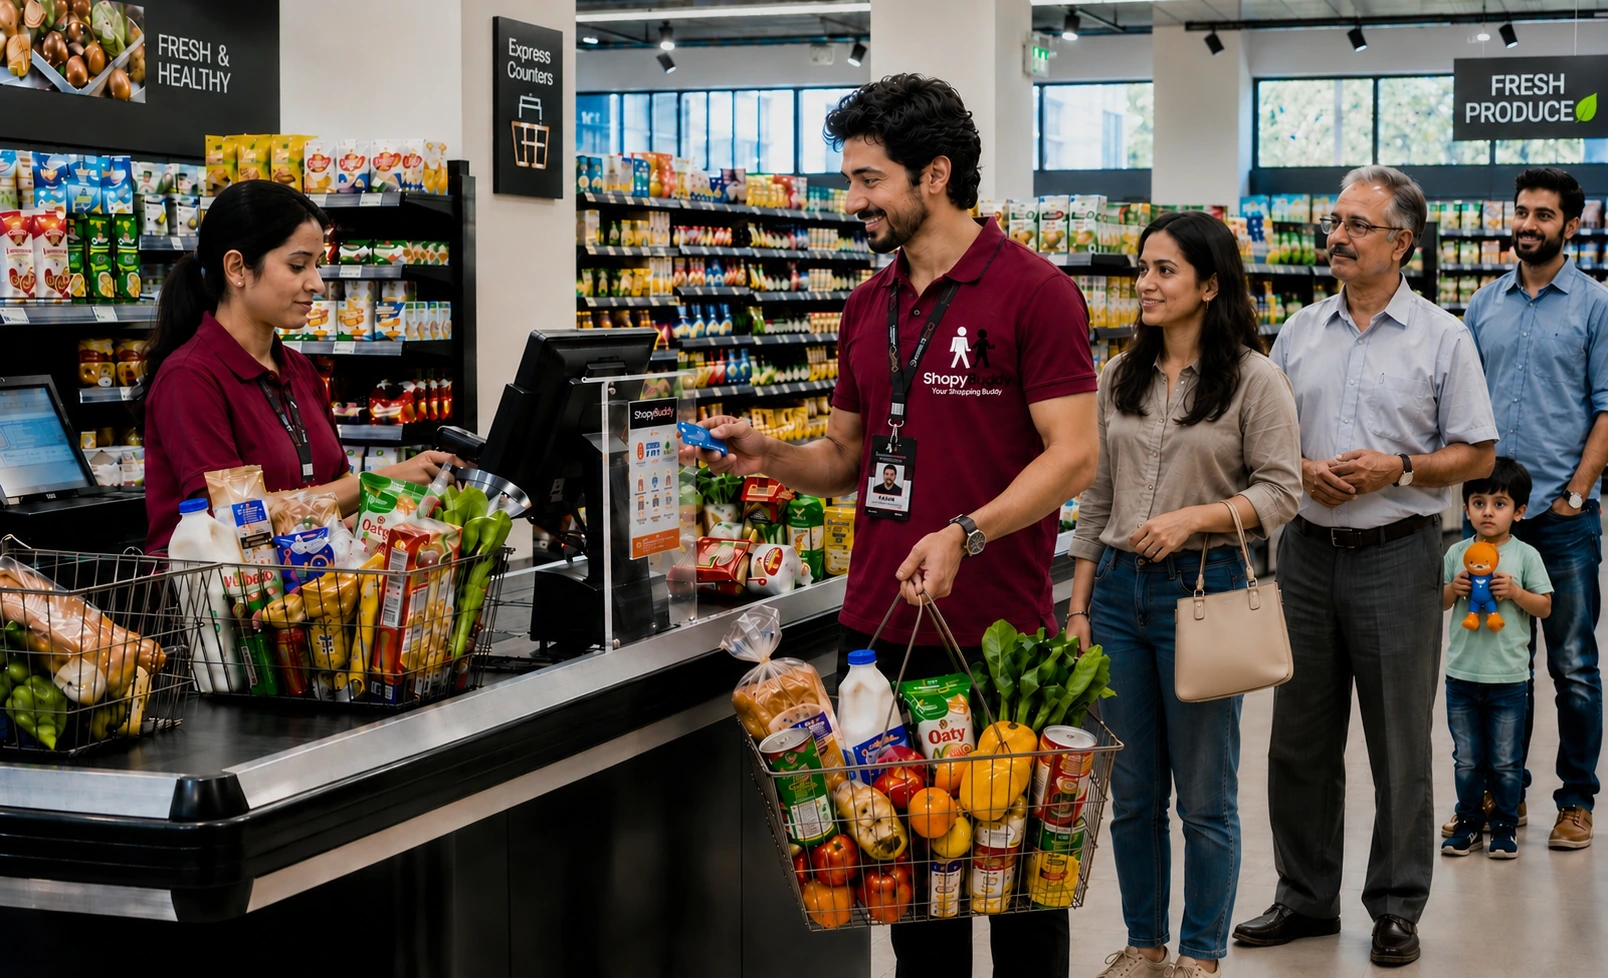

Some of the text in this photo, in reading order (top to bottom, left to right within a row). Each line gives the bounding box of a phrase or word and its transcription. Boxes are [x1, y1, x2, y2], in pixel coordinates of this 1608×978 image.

[158, 33, 230, 67] FRESH &
[508, 37, 551, 64] Express
[158, 61, 231, 93] HEALTHY
[507, 60, 554, 86] Counters
[1491, 73, 1565, 96] FRESH
[1465, 100, 1574, 124] PRODUCE
[932, 387, 1002, 397] Your Shopping Buddy
[928, 727, 966, 744] Oaty
